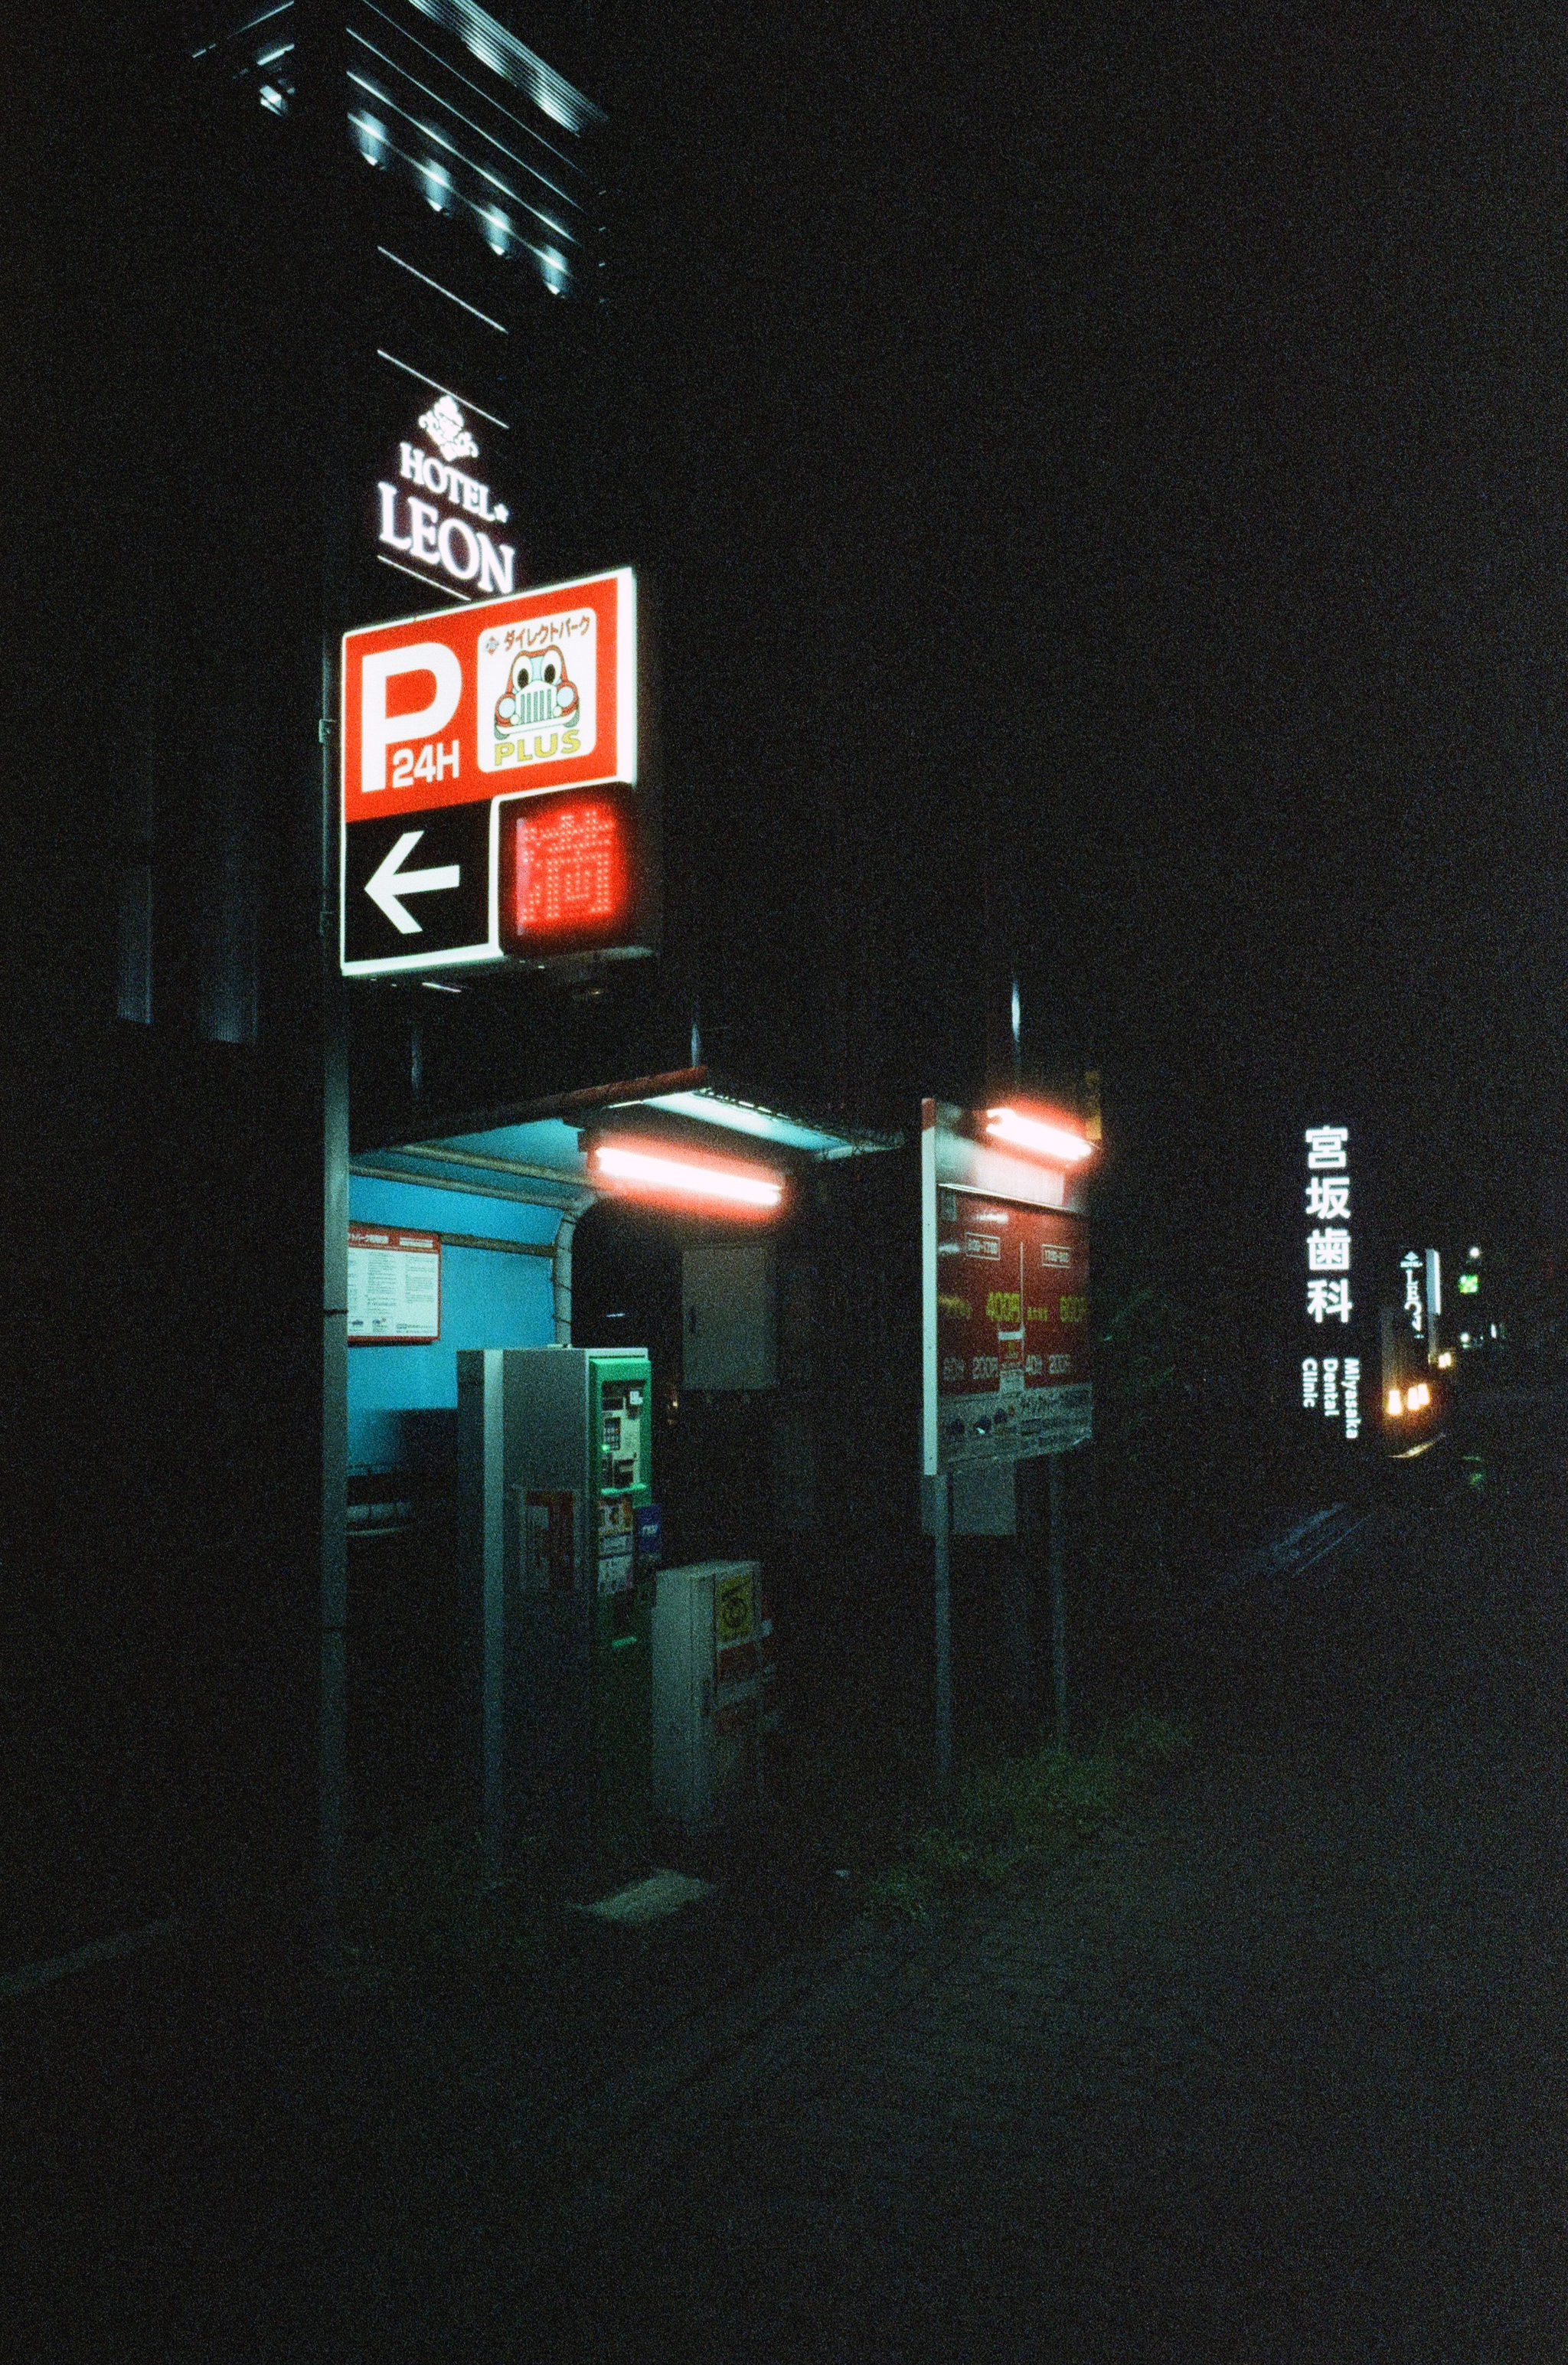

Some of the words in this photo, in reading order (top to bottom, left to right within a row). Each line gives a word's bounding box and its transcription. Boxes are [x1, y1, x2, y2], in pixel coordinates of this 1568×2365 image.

[400, 442, 495, 521] HOTEL
[377, 482, 516, 594] LEON
[504, 615, 590, 652] ダイレクトパーク
[361, 642, 462, 792] P
[495, 729, 582, 766] PLUS
[392, 740, 459, 786] 24H
[517, 808, 617, 924] 満
[1305, 1125, 1353, 1323] 宮坂歯科
[1302, 1358, 1318, 1408] Clinic
[1323, 1358, 1340, 1416] Dental
[1341, 1358, 1361, 1439] Miyasaka
